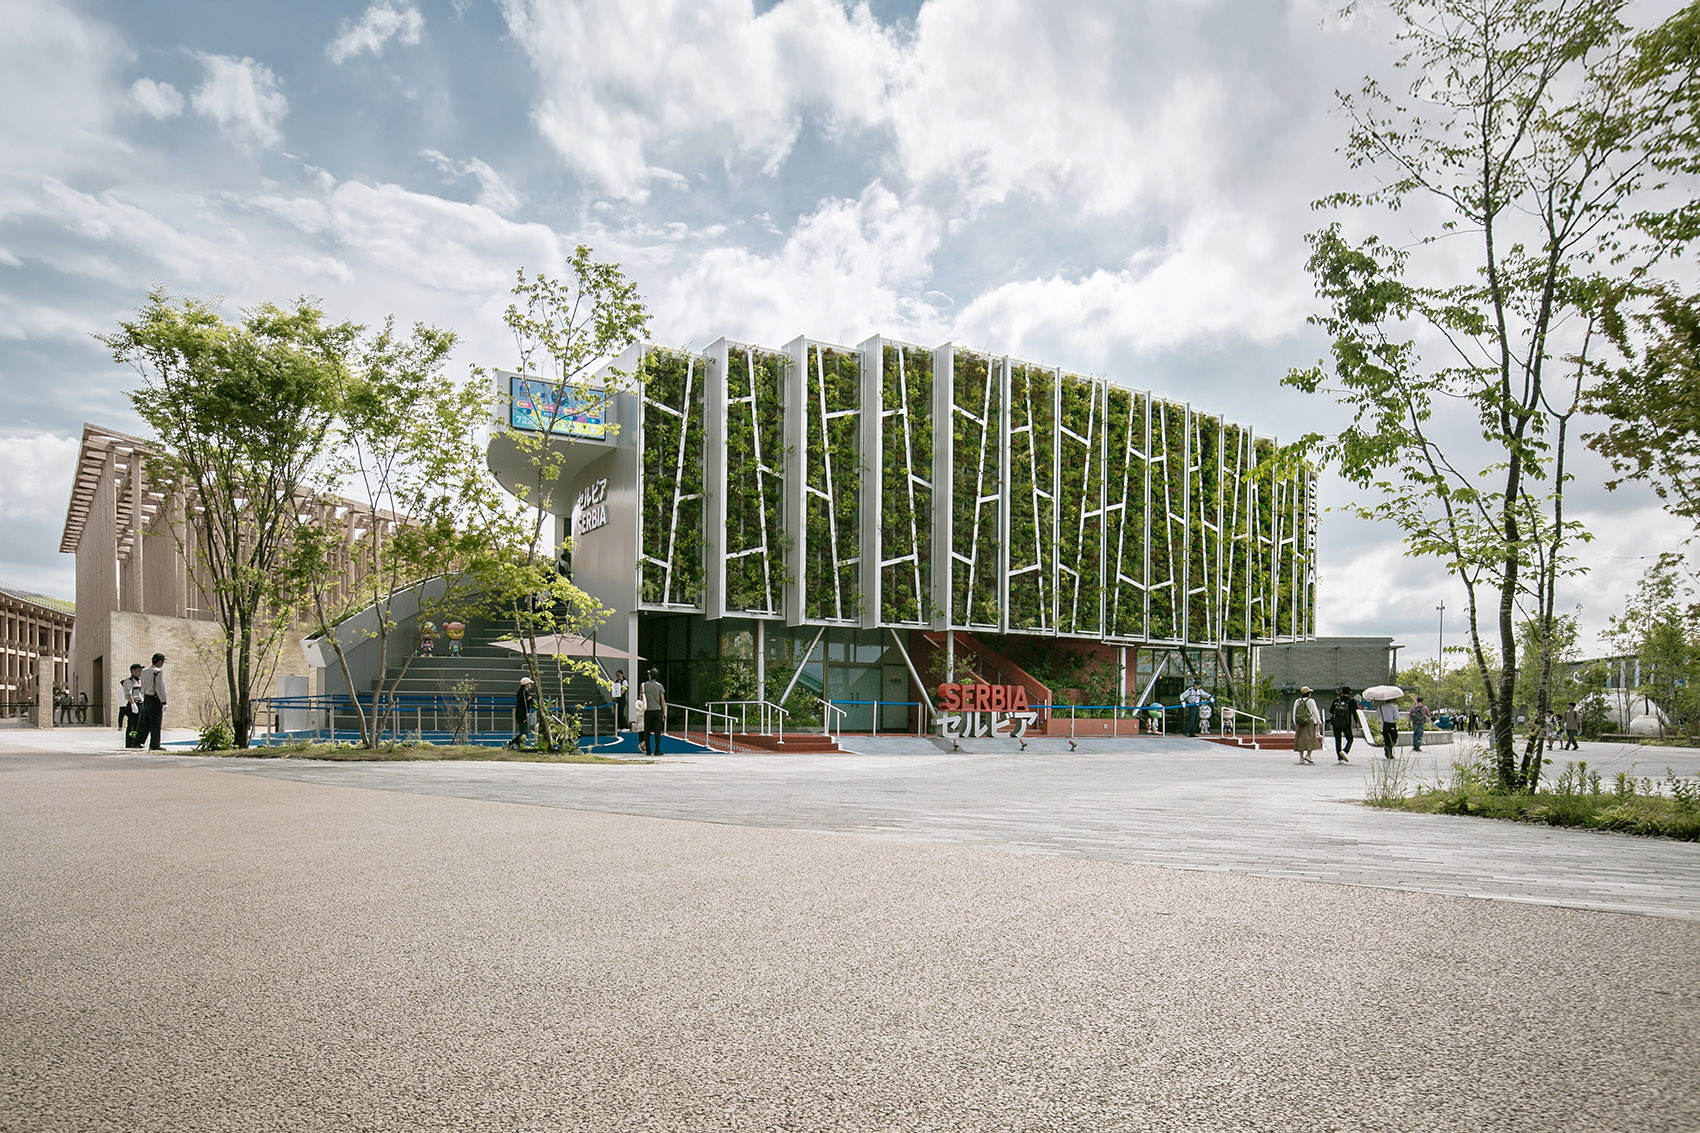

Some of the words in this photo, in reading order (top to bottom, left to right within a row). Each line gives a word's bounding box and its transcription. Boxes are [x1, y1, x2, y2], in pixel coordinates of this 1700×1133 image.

[577, 478, 607, 510] セルビア
[578, 504, 607, 535] SERBIA
[1308, 481, 1318, 585] SERBIA
[938, 683, 1030, 711] SERBIA
[937, 711, 1039, 738] セルビア
